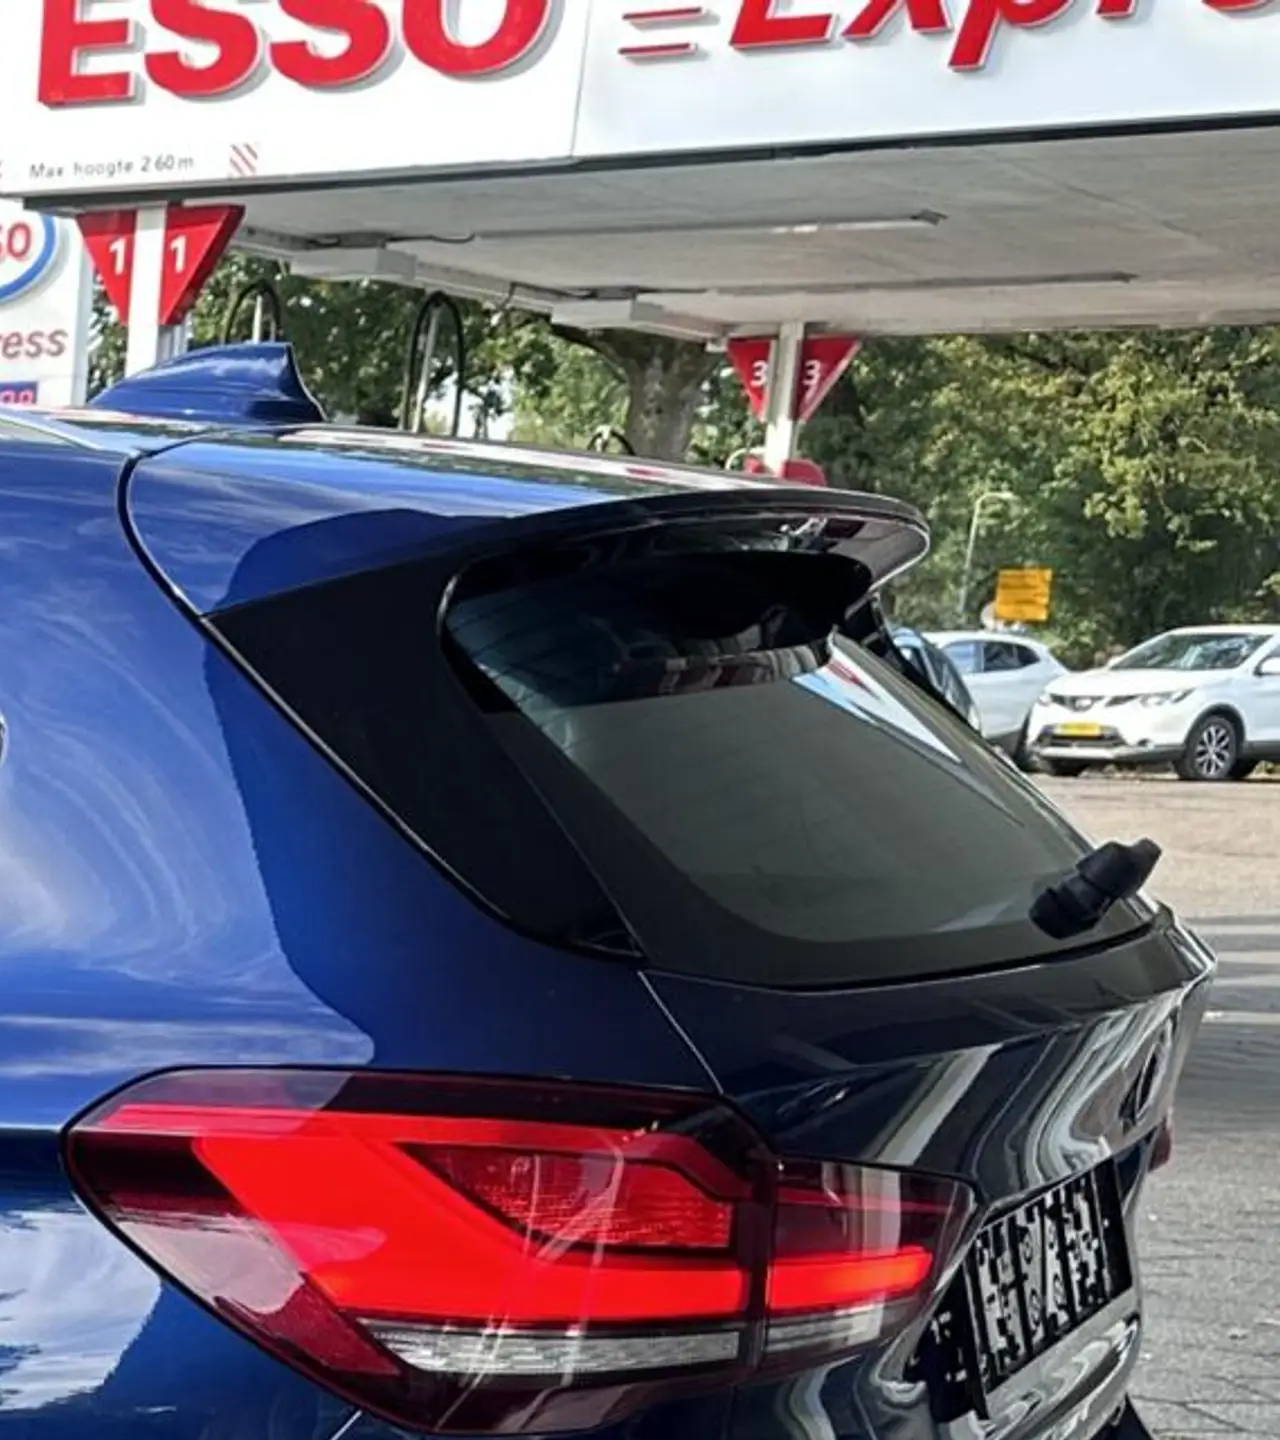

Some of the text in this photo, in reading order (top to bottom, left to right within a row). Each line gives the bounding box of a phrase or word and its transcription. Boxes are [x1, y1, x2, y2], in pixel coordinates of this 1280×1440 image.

[72, 159, 134, 179] hoogte
[109, 237, 125, 275] 1
[170, 235, 186, 273] 1
[750, 359, 768, 386] 3
[803, 359, 821, 386] 3
